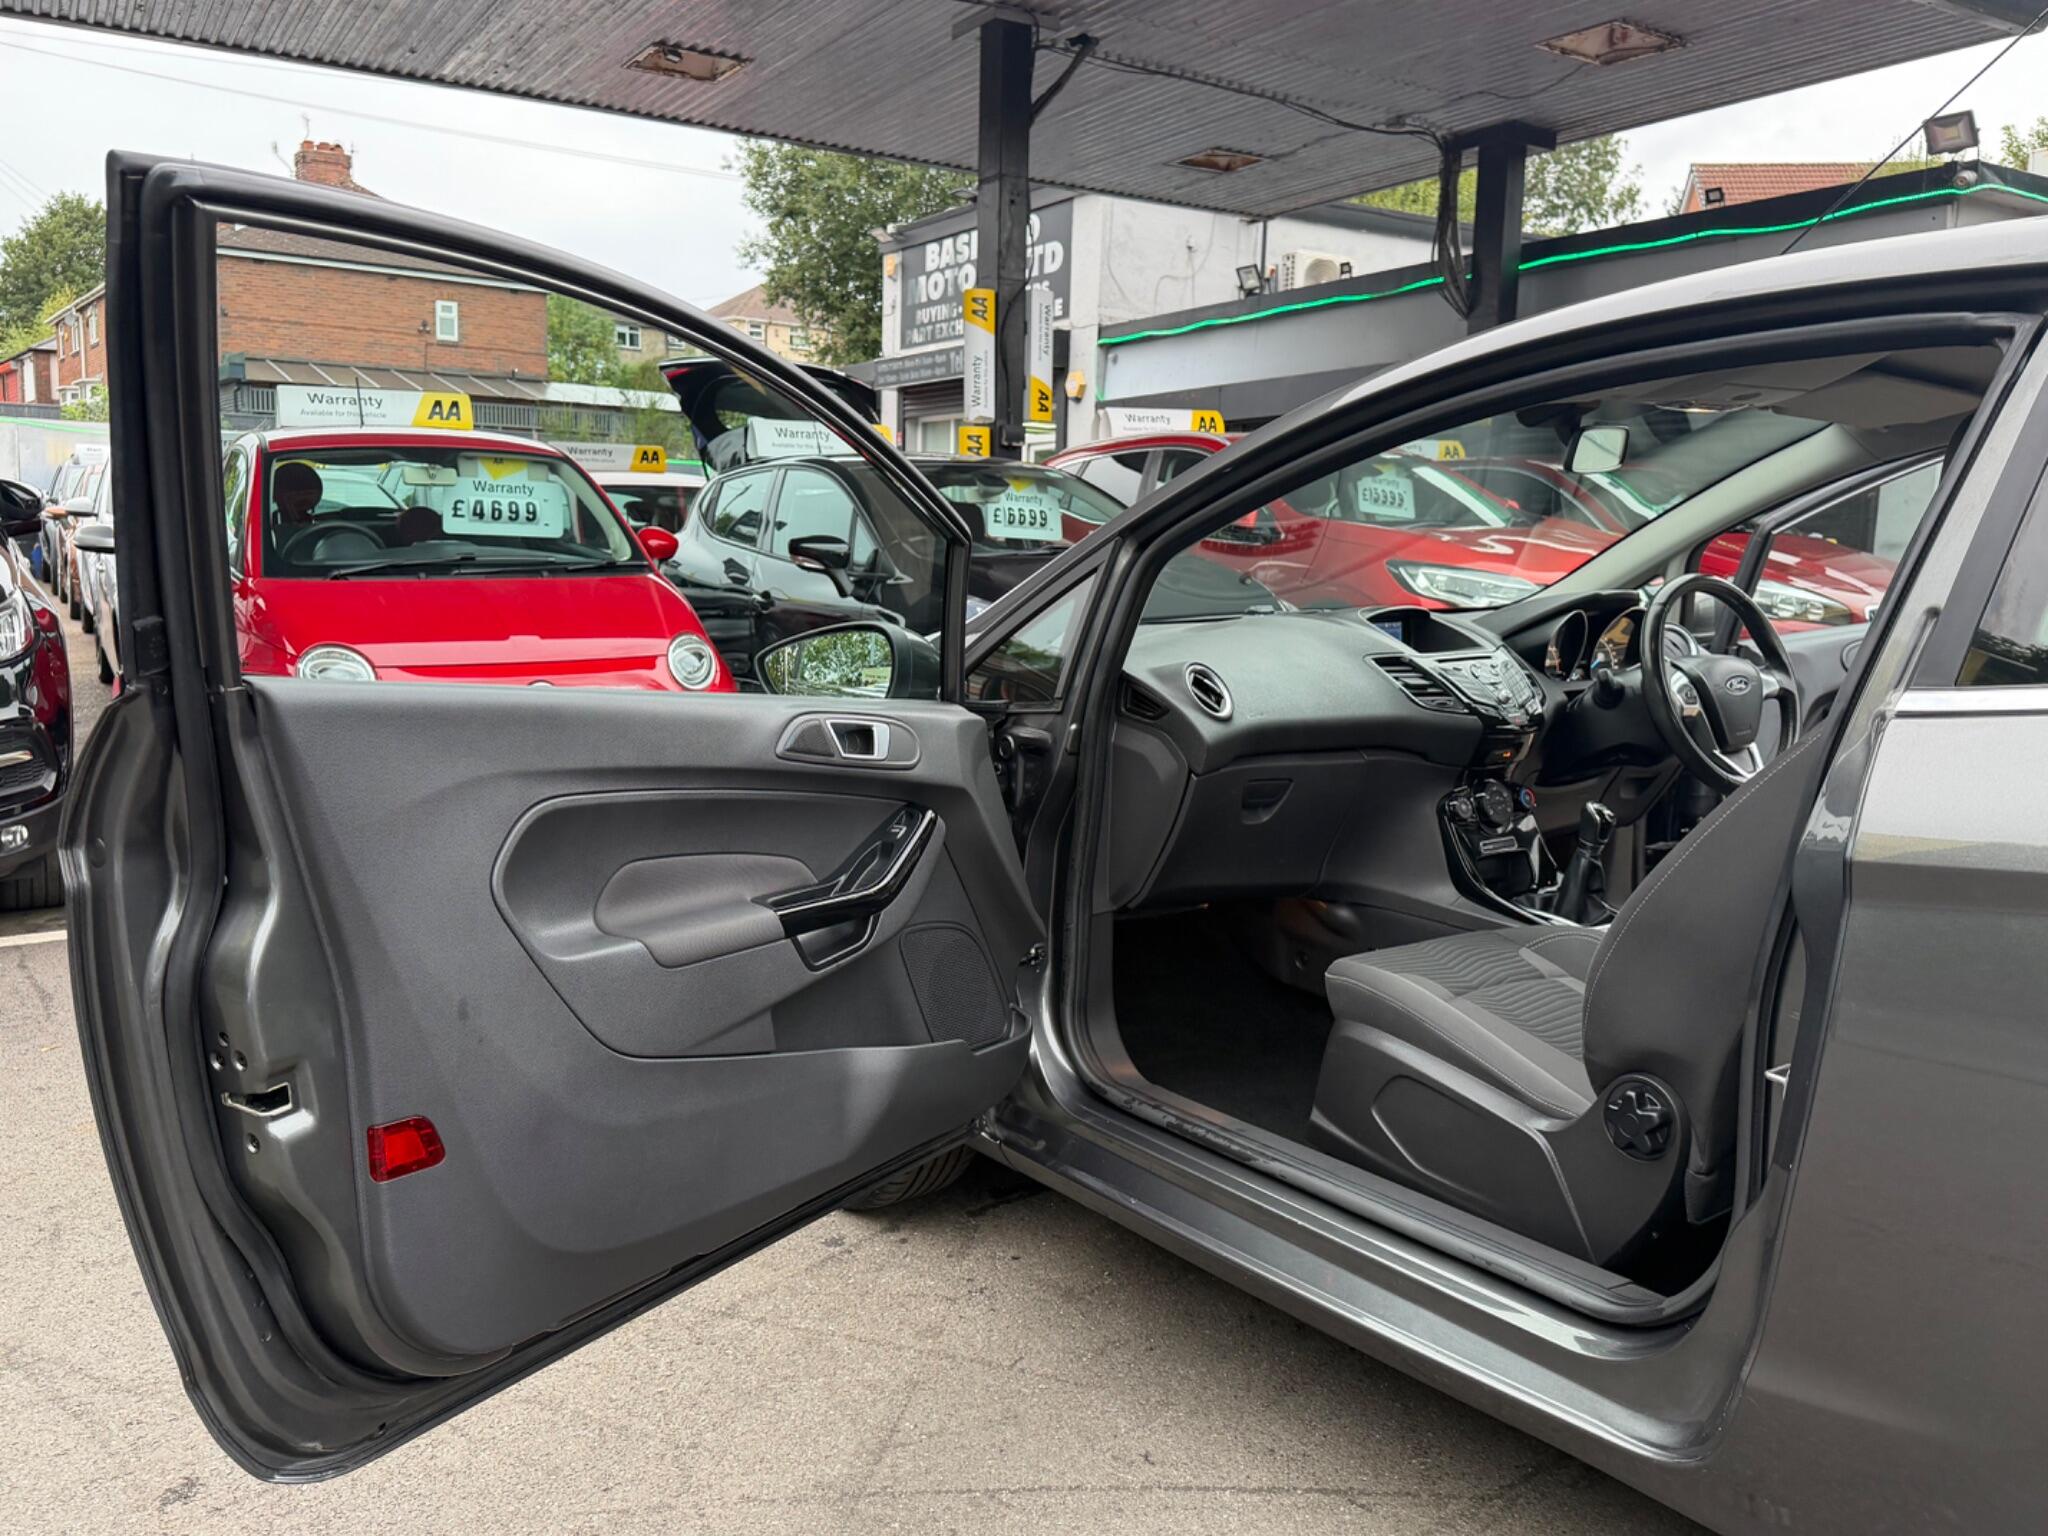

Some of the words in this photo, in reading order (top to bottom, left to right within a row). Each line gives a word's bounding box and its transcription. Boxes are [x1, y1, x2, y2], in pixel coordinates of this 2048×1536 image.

[971, 297, 988, 323] AA
[1043, 304, 1052, 356] Warranty
[972, 355, 984, 407] Warranty
[307, 392, 383, 409] Warranty
[427, 400, 461, 421] AA
[1037, 389, 1050, 414] AA
[1125, 413, 1171, 425] Warranty
[1199, 416, 1217, 433] AA
[774, 427, 830, 442] Warranty
[567, 446, 614, 457] Warranty
[640, 451, 660, 464] AA
[1444, 445, 1459, 459] AA
[473, 480, 534, 497] Warranty
[1004, 491, 1043, 506] Warranty
[452, 499, 537, 522] £4699
[993, 507, 1048, 527] £6699
